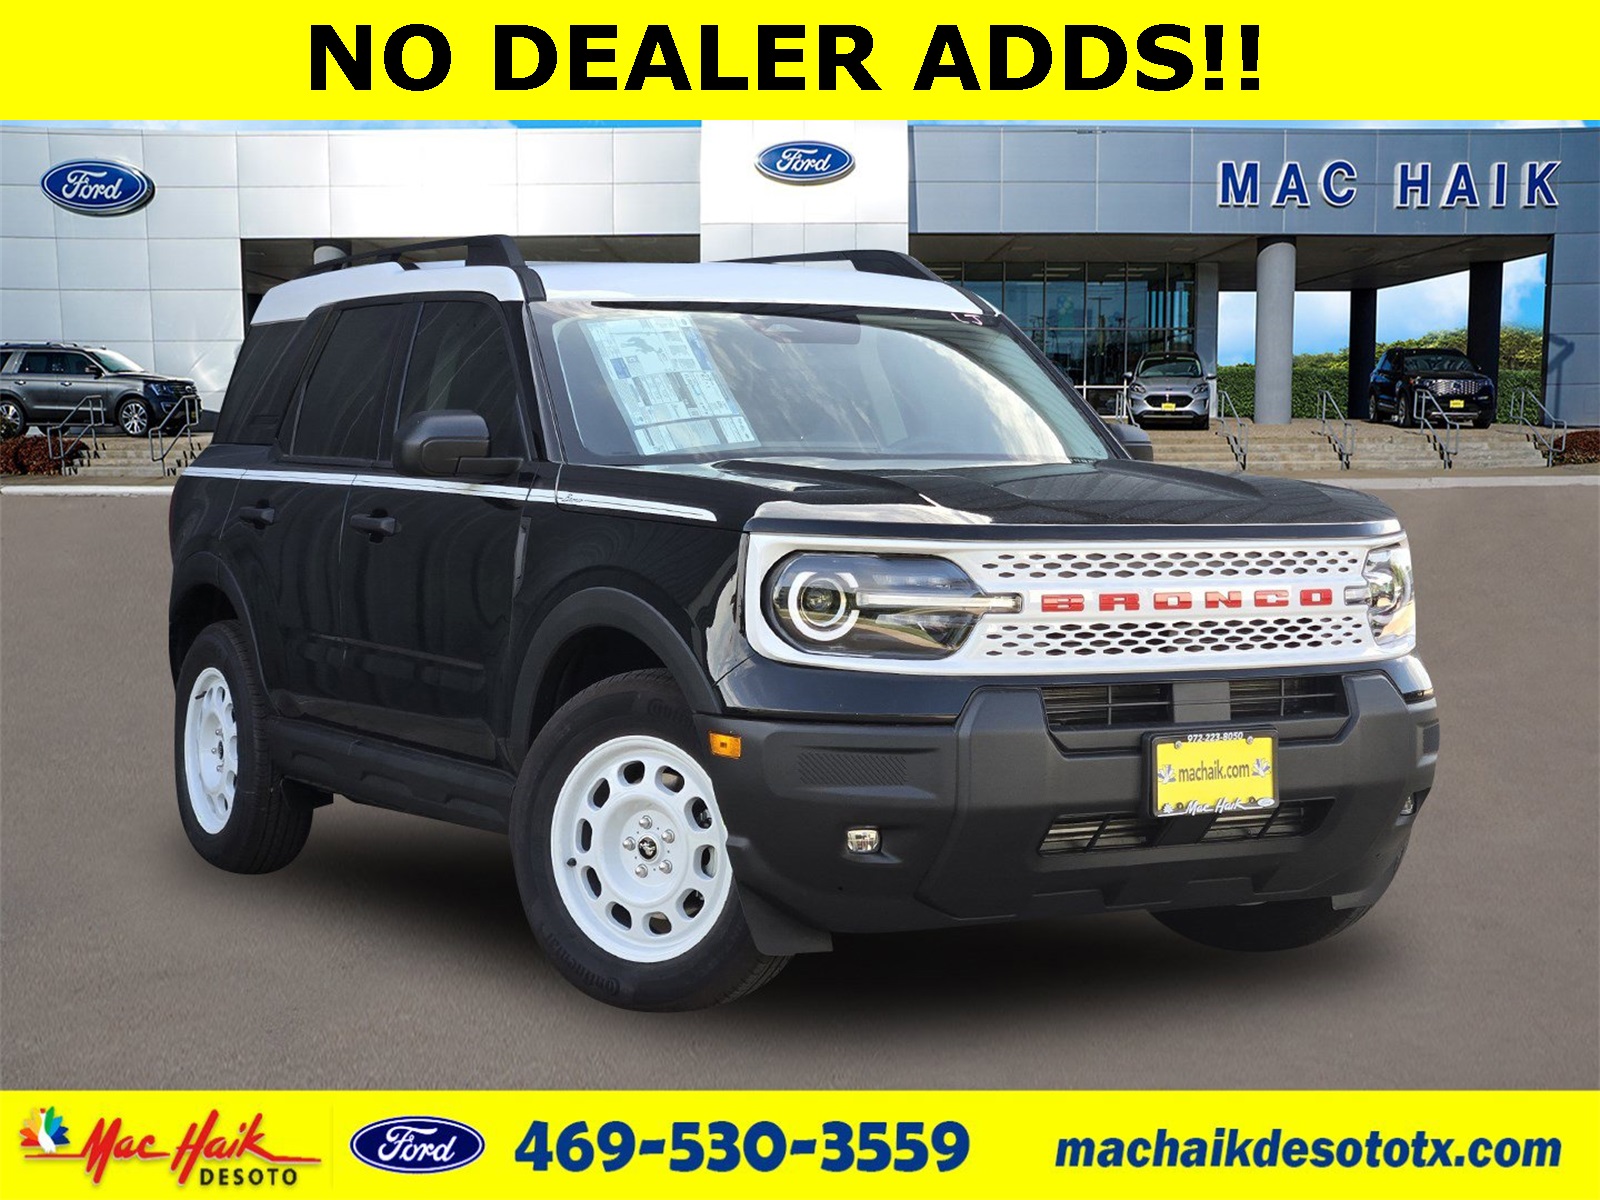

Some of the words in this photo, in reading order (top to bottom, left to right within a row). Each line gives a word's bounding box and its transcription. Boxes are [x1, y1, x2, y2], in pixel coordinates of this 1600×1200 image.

[778, 148, 832, 172] Ford
[62, 170, 124, 200] Ford
[1218, 160, 1357, 207] MAC
[1394, 161, 1562, 208] HAIK
[1041, 588, 1333, 612] BRONCO
[1187, 731, 1244, 743] 972-223-8050
[1178, 759, 1250, 782] machaik.com
[1185, 799, 1214, 816] Mac
[1214, 797, 1246, 814] Haik
